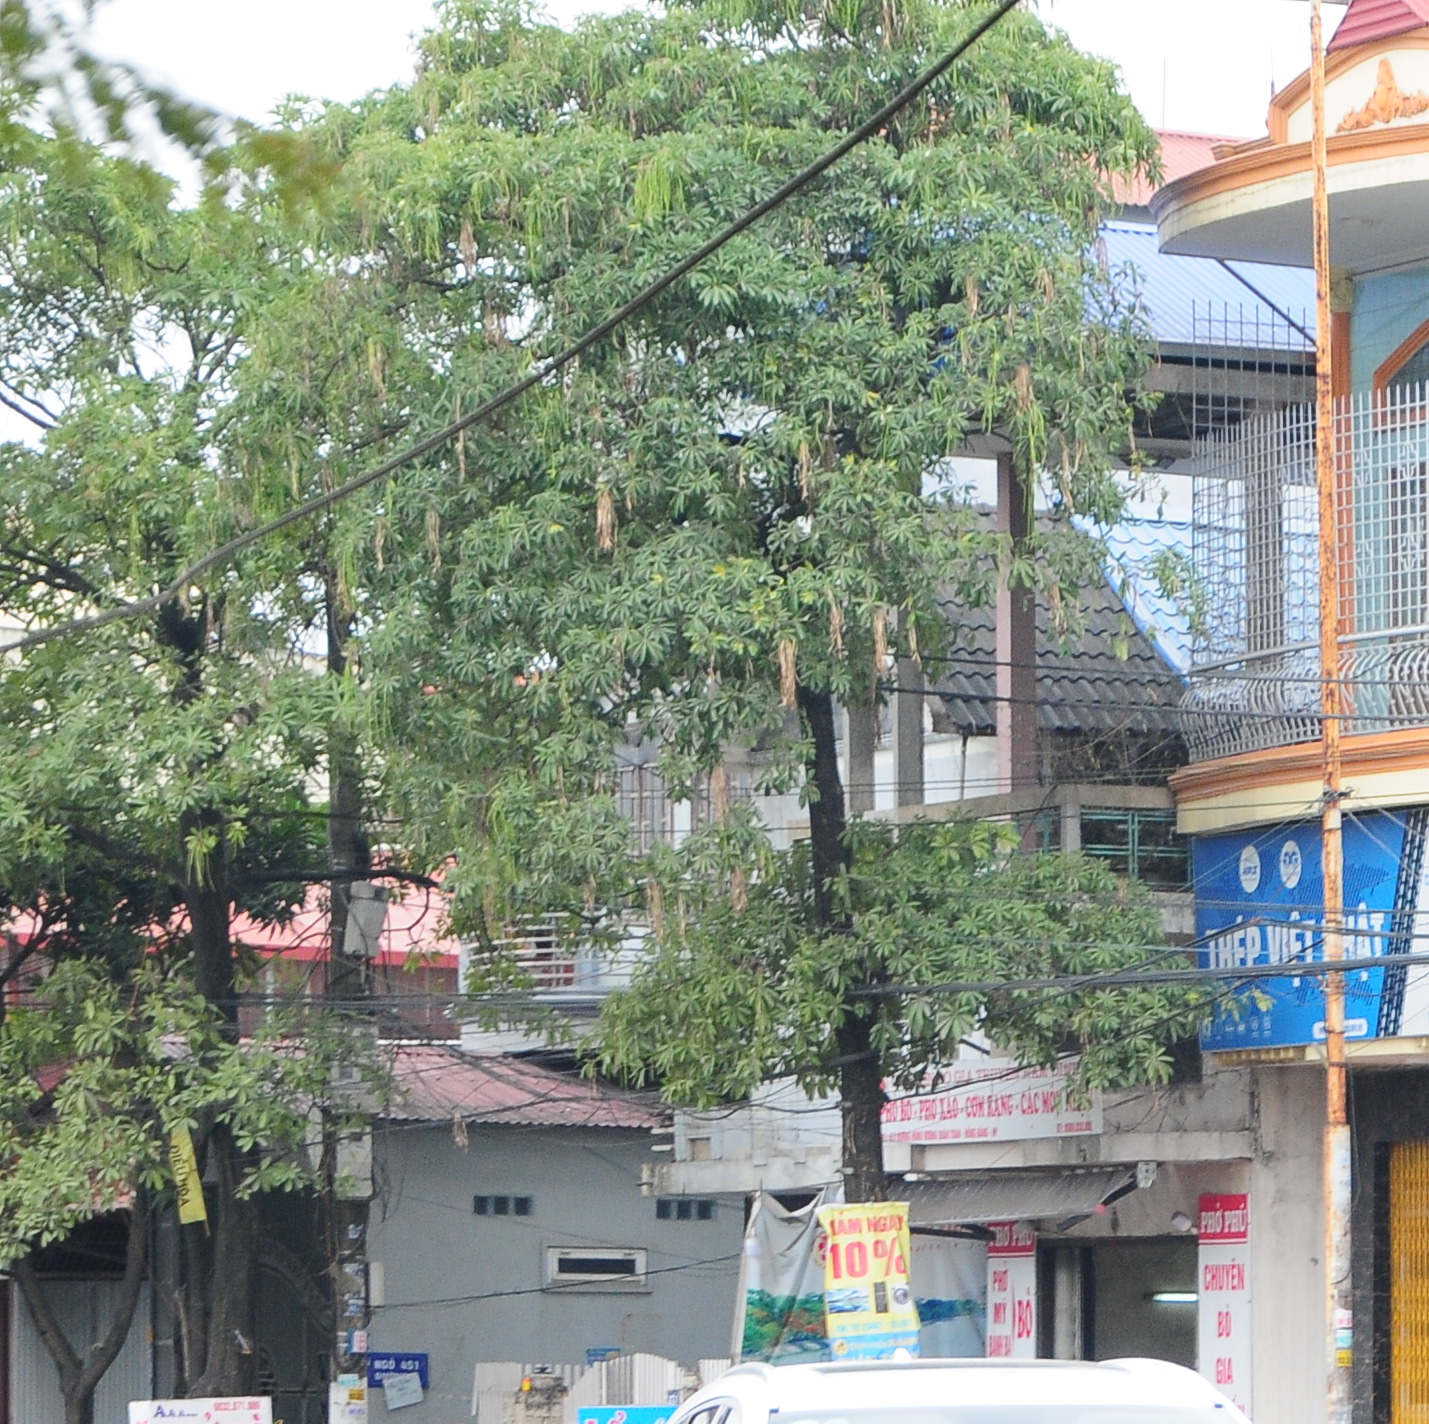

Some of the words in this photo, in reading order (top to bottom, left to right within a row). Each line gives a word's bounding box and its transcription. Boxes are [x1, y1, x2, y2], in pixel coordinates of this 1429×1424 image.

[1206, 914, 1262, 970] THÉP
[829, 1237, 907, 1280] 10%
[1216, 1357, 1234, 1385] GIA
